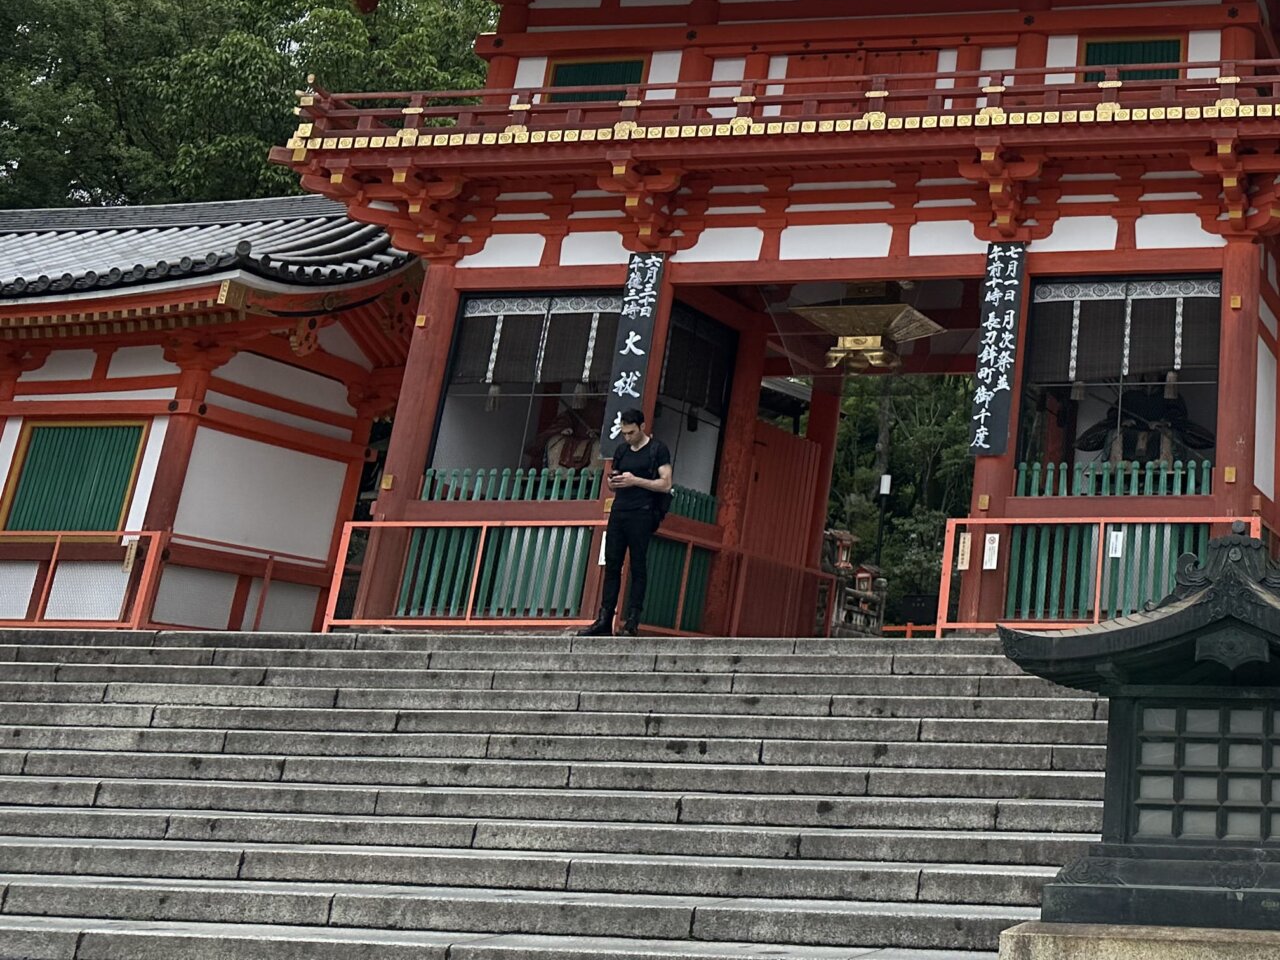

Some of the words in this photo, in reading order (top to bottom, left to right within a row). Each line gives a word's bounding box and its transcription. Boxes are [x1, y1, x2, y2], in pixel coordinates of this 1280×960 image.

[637, 255, 663, 318] 六月三十日
[984, 244, 1005, 307] 午前十時
[1003, 245, 1023, 302] 七月一日
